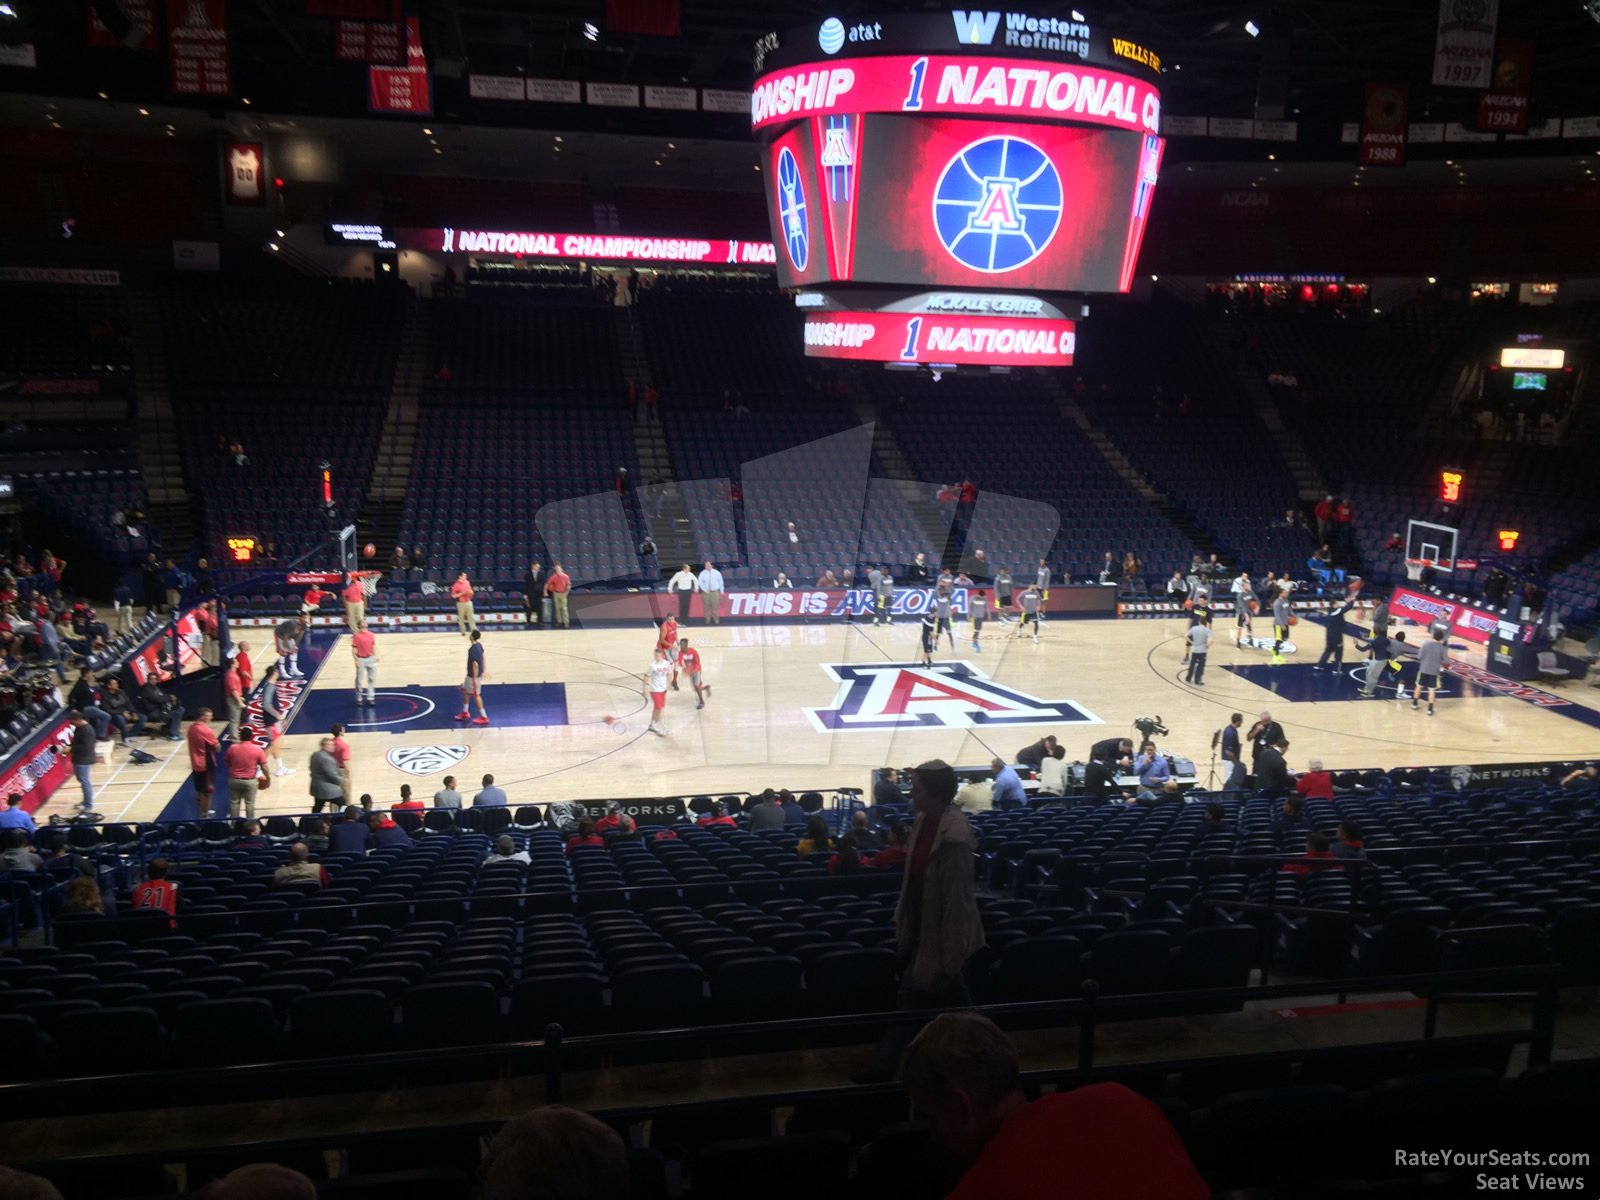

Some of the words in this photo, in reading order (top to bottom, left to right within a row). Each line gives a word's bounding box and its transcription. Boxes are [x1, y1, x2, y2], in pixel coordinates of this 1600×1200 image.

[849, 21, 882, 42] at&t
[1005, 12, 1090, 38] Western
[1005, 30, 1089, 58] Refining
[1112, 37, 1148, 66] WELLS
[1439, 46, 1492, 58] ARIZONA
[1445, 66, 1482, 82] 1997
[902, 57, 928, 111] 1
[936, 65, 1138, 123] NATIONAL
[1482, 95, 1527, 107] ARIZONA
[1487, 112, 1519, 126] 1994
[1363, 133, 1404, 144] ARIZONA
[1369, 148, 1397, 160] 1988
[968, 176, 1026, 235] A
[1221, 191, 1269, 206] NCAA
[459, 231, 559, 255] NATIONAL
[564, 236, 711, 261] CHAMPIONSHIP
[991, 299, 1042, 314] CENTER
[901, 316, 922, 360] 1
[926, 327, 1057, 354] NATIONAL
[728, 593, 793, 615] THIS
[799, 592, 829, 614] IS
[832, 588, 968, 616] ARZONA
[800, 660, 1106, 733] A
[1472, 767, 1551, 780] NETWORKS
[142, 887, 165, 907] 21
